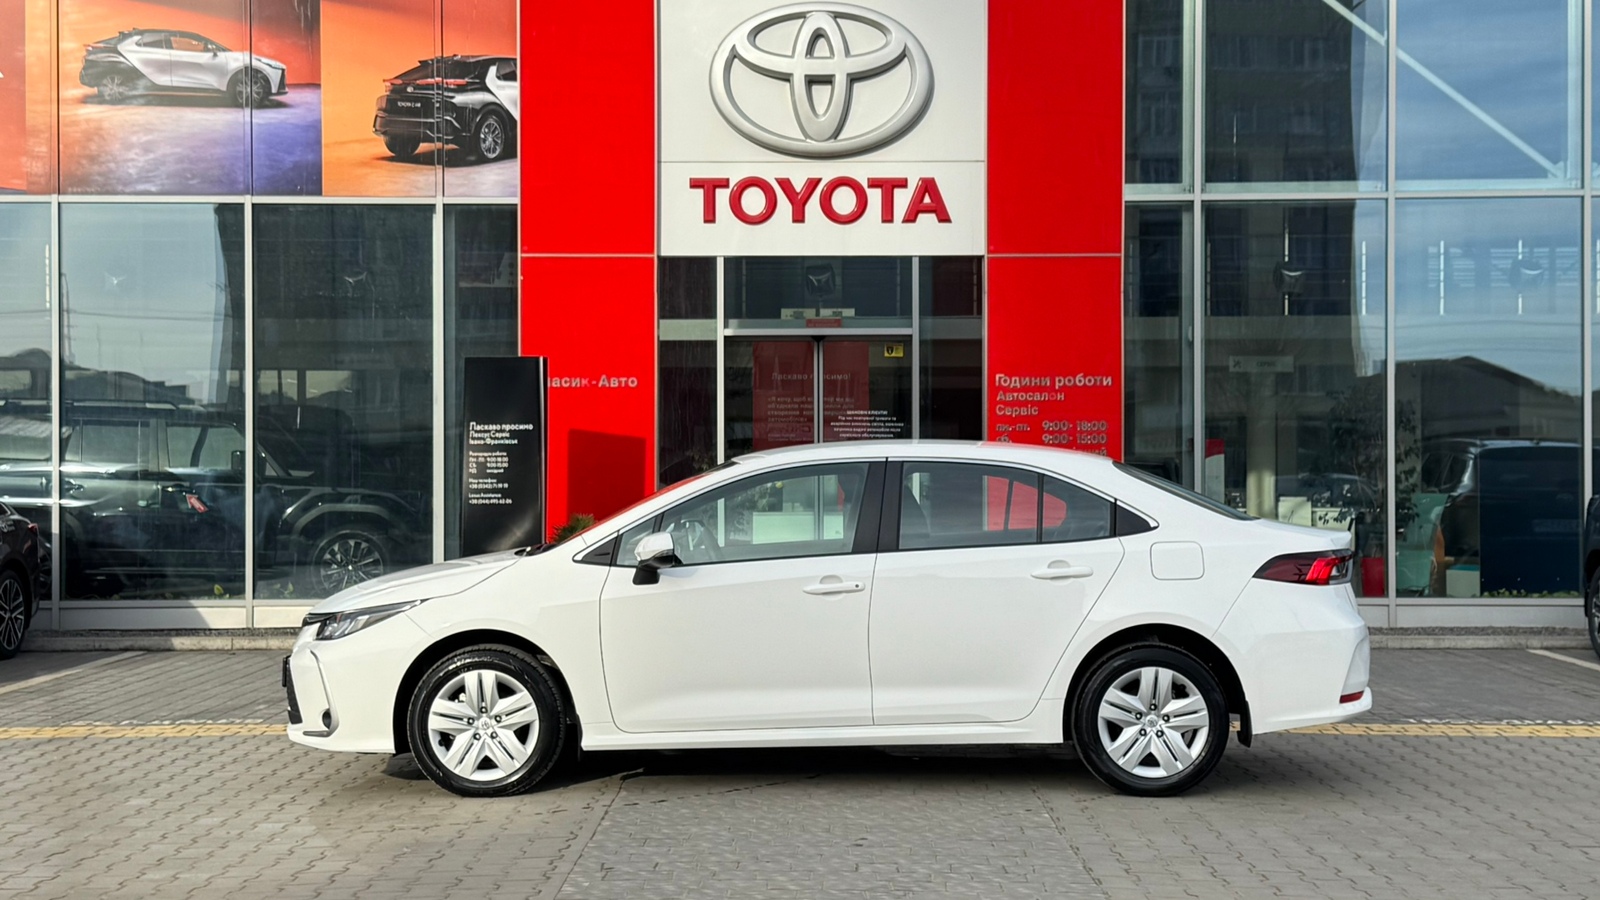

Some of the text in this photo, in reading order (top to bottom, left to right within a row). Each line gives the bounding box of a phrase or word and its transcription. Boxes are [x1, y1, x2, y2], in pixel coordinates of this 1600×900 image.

[689, 175, 952, 225] TOYOTA
[995, 373, 1112, 389] Години роботи
[996, 391, 1065, 401] Автосалон
[996, 404, 1039, 417] Сервіс
[470, 422, 501, 430] Ласкаво
[1076, 420, 1107, 432] 18:00
[469, 438, 518, 446] Івано-Франківськ
[1076, 433, 1107, 444] 15:00
